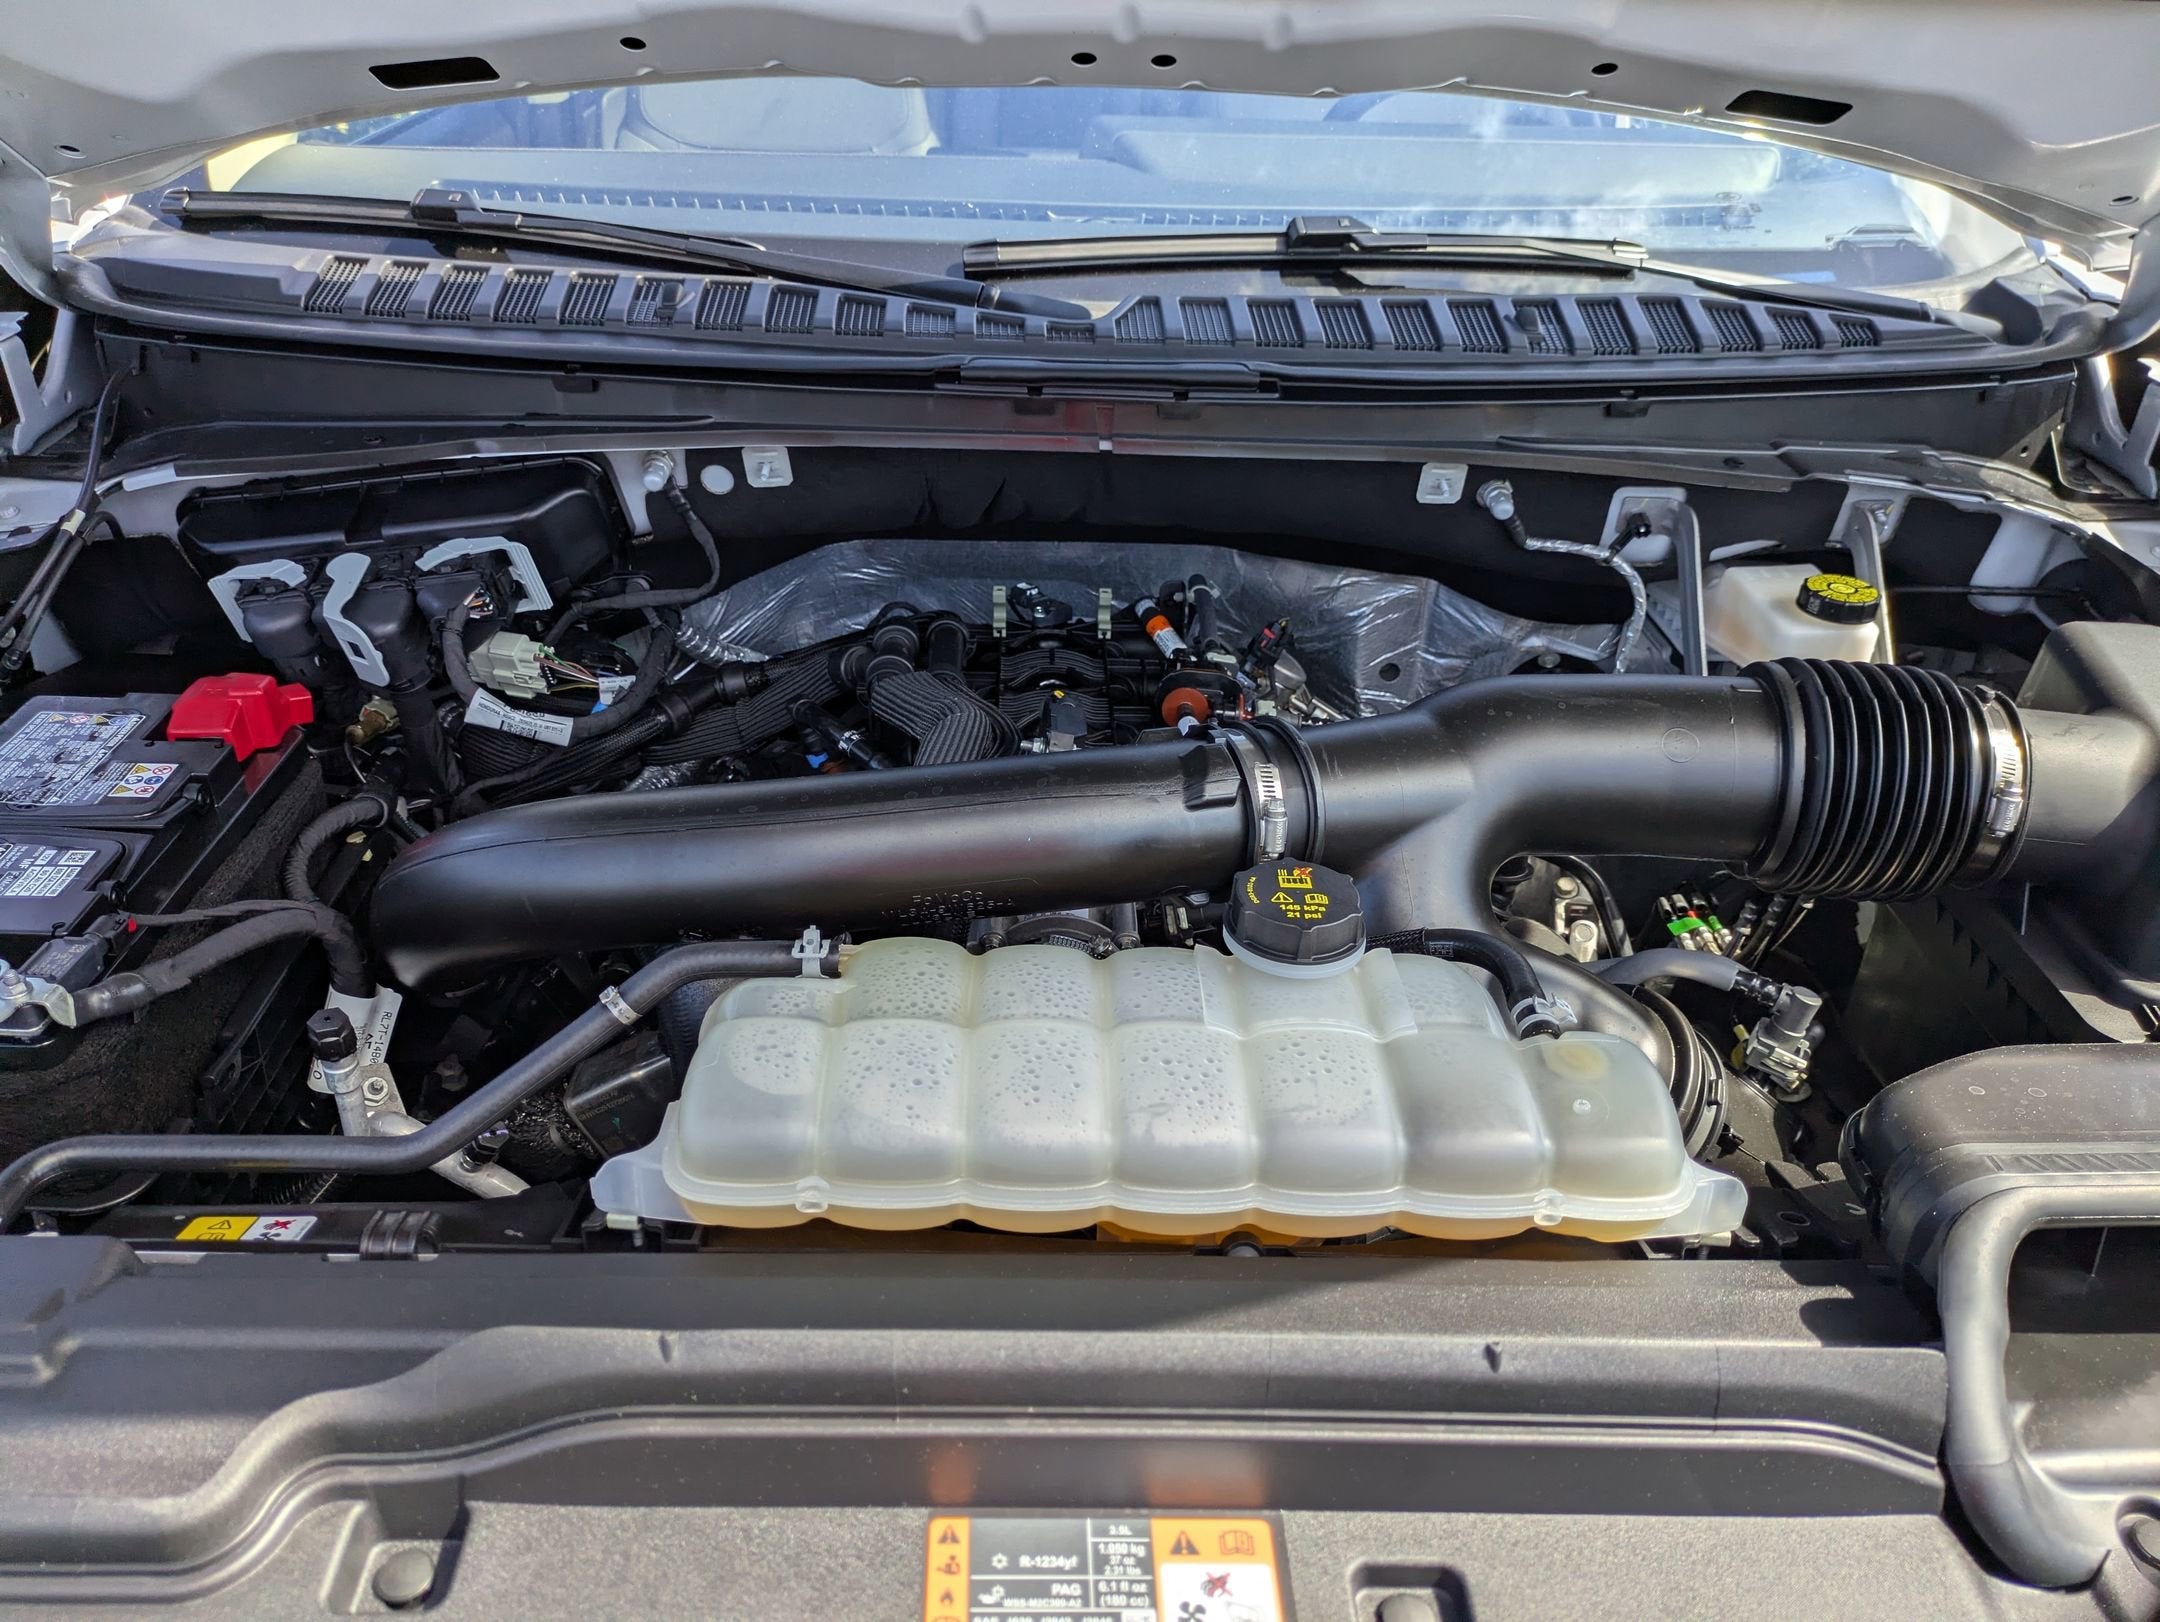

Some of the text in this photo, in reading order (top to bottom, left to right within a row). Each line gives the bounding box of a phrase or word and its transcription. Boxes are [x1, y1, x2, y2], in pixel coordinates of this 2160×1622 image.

[1303, 904, 1326, 912] kPa
[1304, 912, 1322, 920] psi
[1130, 1543, 1146, 1557] kg
[1019, 1554, 1078, 1570] R-1234yf
[1051, 1583, 1082, 1596] PAG
[1131, 1583, 1148, 1593] oz
